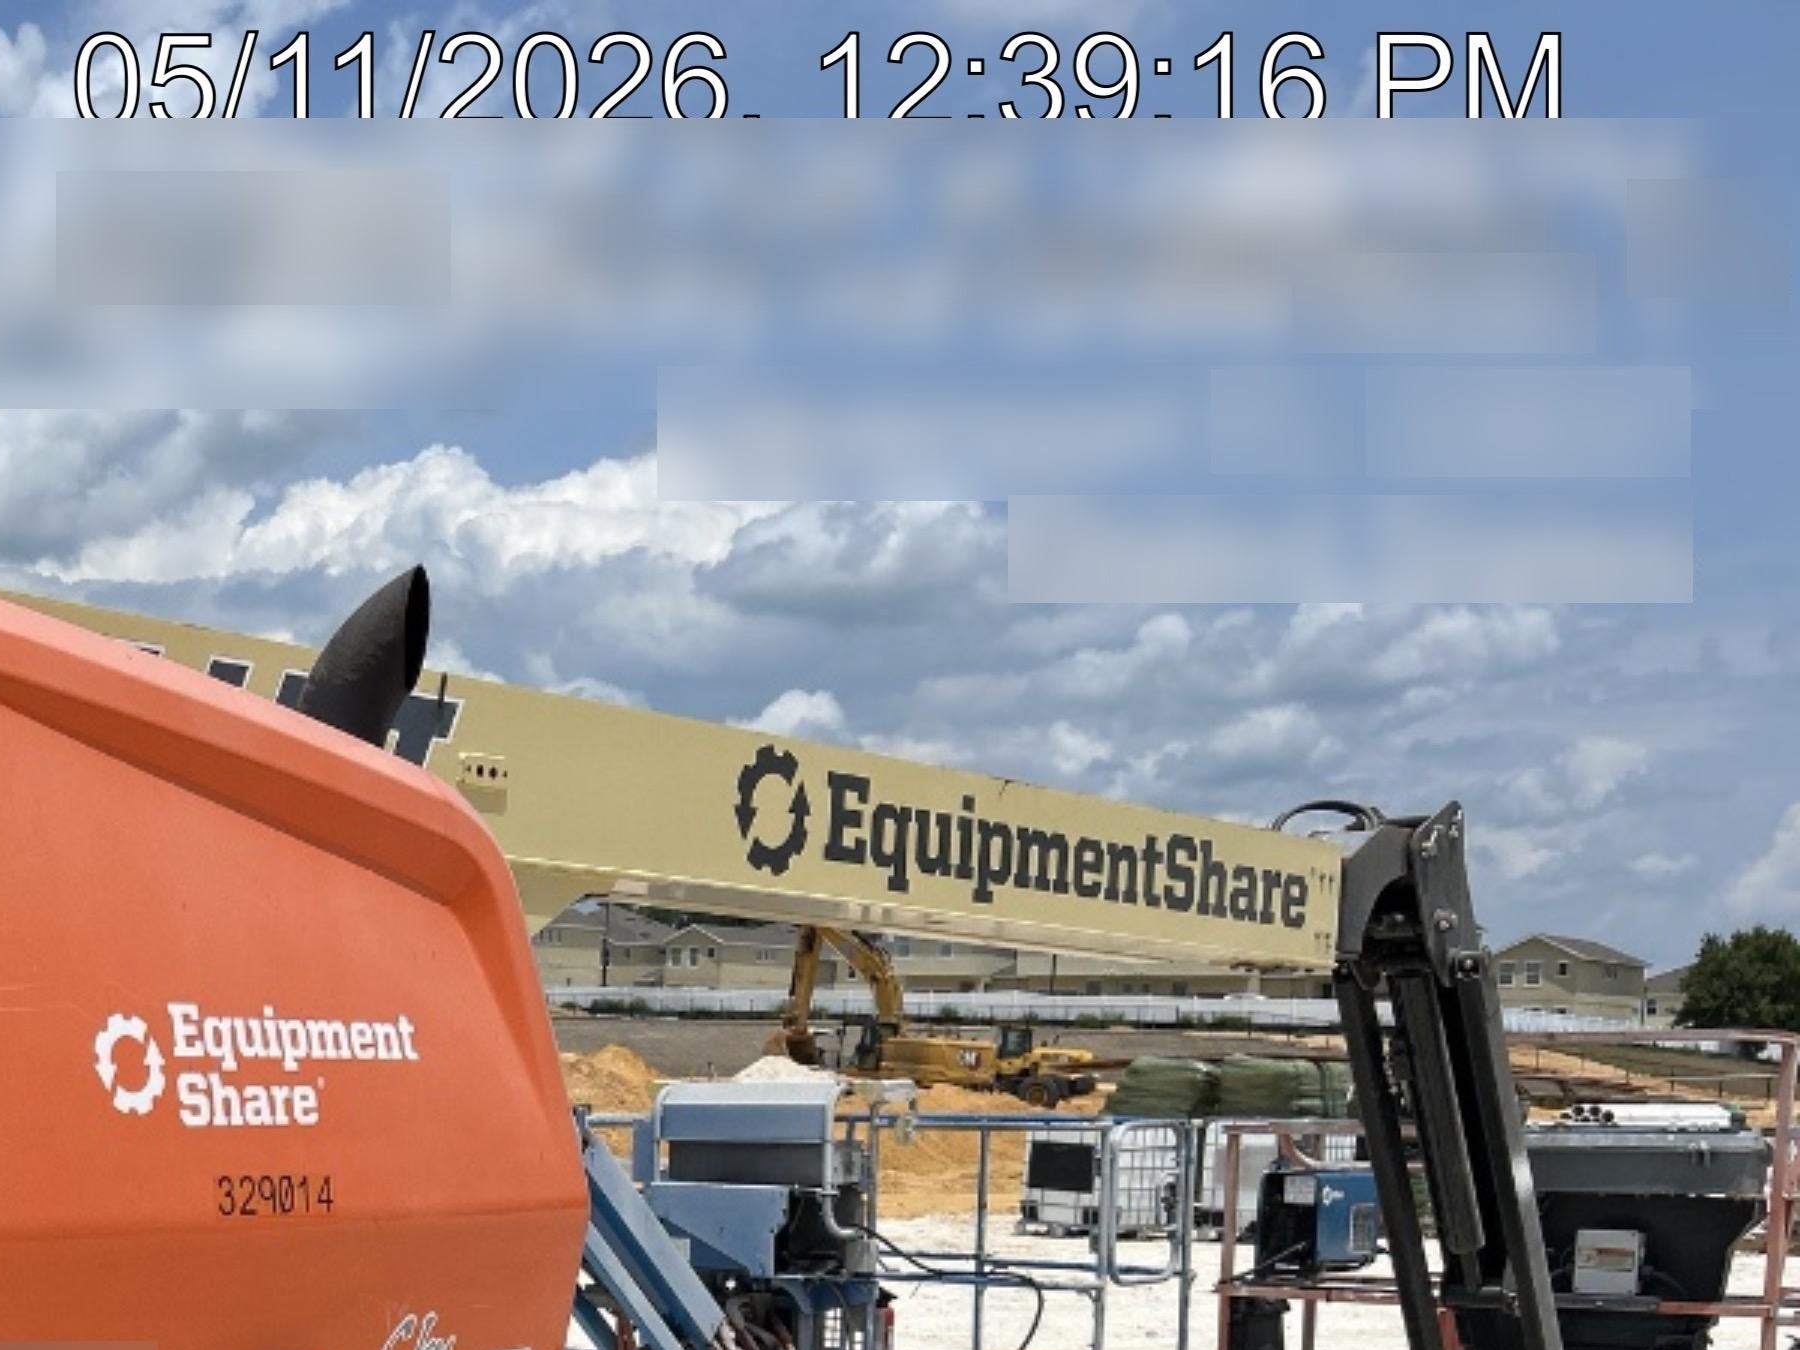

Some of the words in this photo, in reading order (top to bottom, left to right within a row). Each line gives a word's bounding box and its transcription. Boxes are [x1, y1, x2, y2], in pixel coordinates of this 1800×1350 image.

[824, 770, 1308, 929] EquipmentShare
[167, 1002, 419, 1072] Equipment
[176, 1072, 320, 1127] Share
[217, 1175, 334, 1216] 329014
